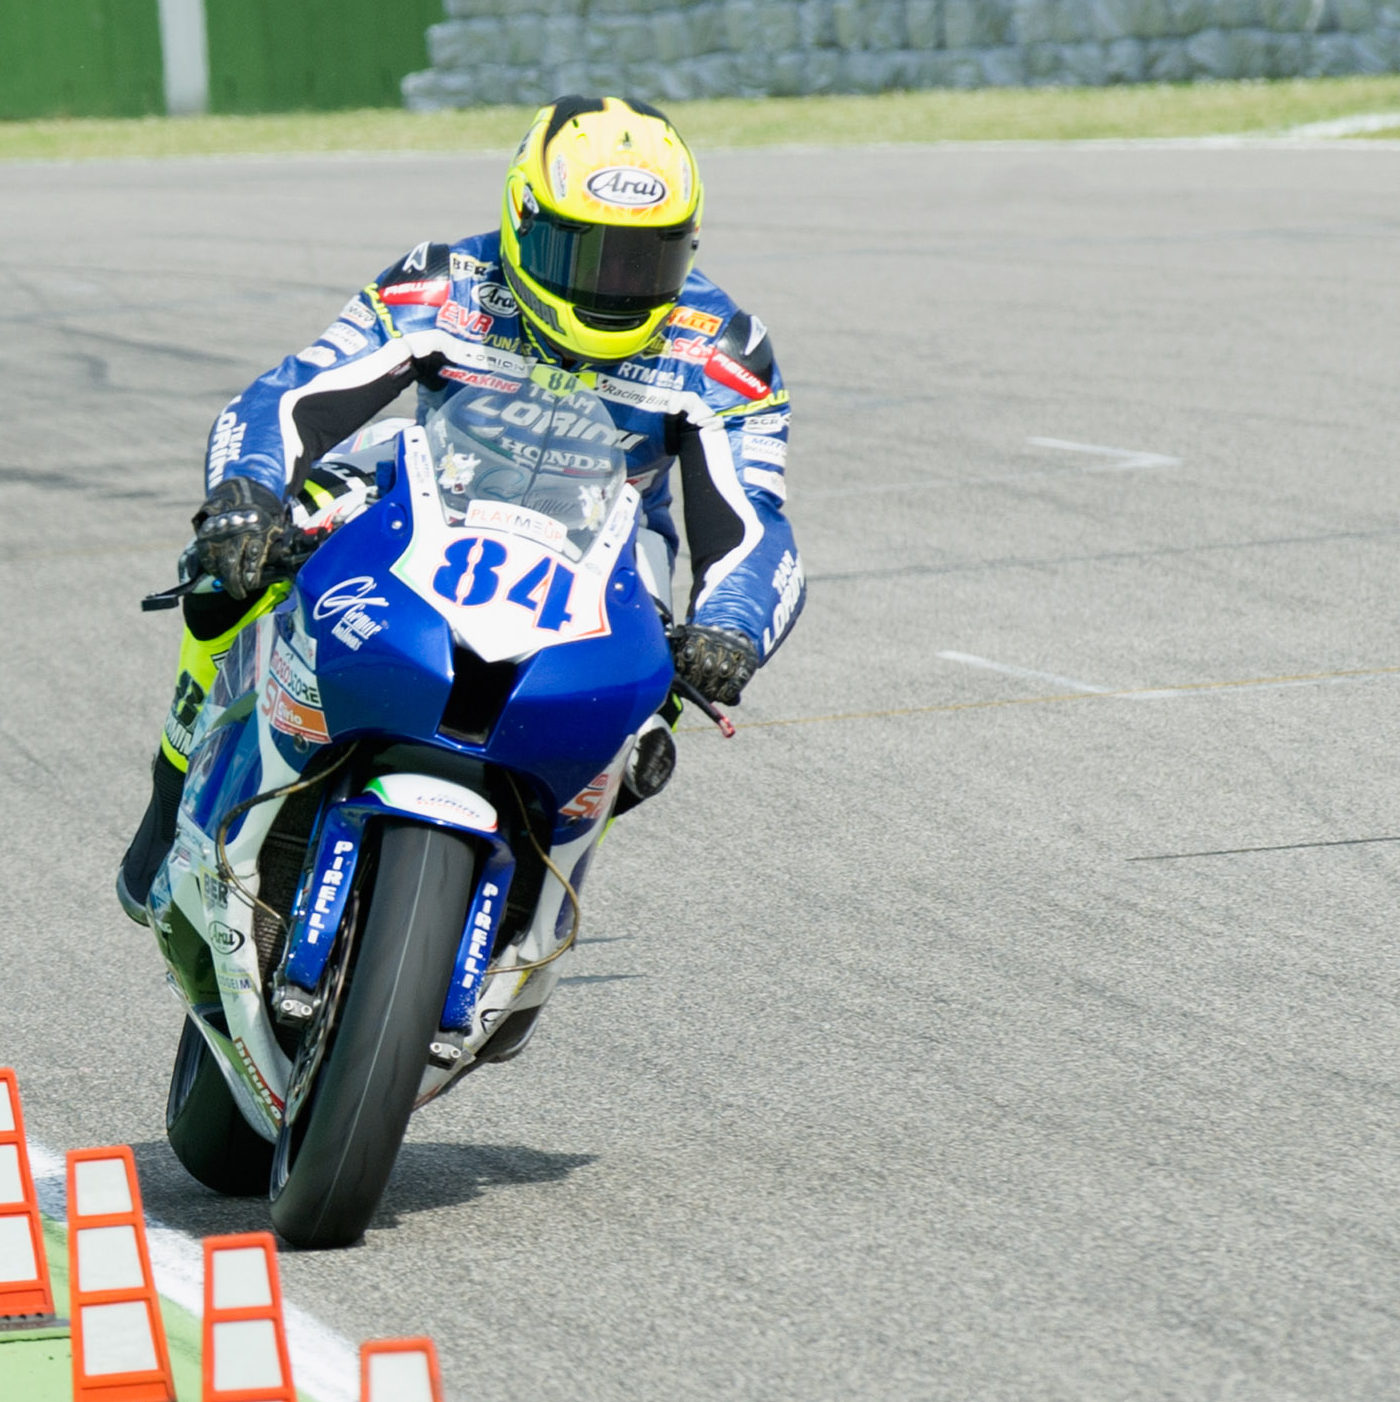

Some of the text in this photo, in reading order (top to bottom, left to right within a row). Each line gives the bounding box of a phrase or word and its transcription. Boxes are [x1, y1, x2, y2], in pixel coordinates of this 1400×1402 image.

[592, 172, 659, 197] Arai
[440, 302, 493, 333] EVR
[440, 366, 521, 393] BRAKING
[549, 372, 577, 392] 84
[529, 383, 595, 414] TEAM
[467, 395, 645, 451] LORINI
[501, 437, 612, 470] HONDA
[431, 536, 576, 632] 84
[307, 840, 354, 945] PIRELLI
[461, 882, 499, 989] PIRELLI
